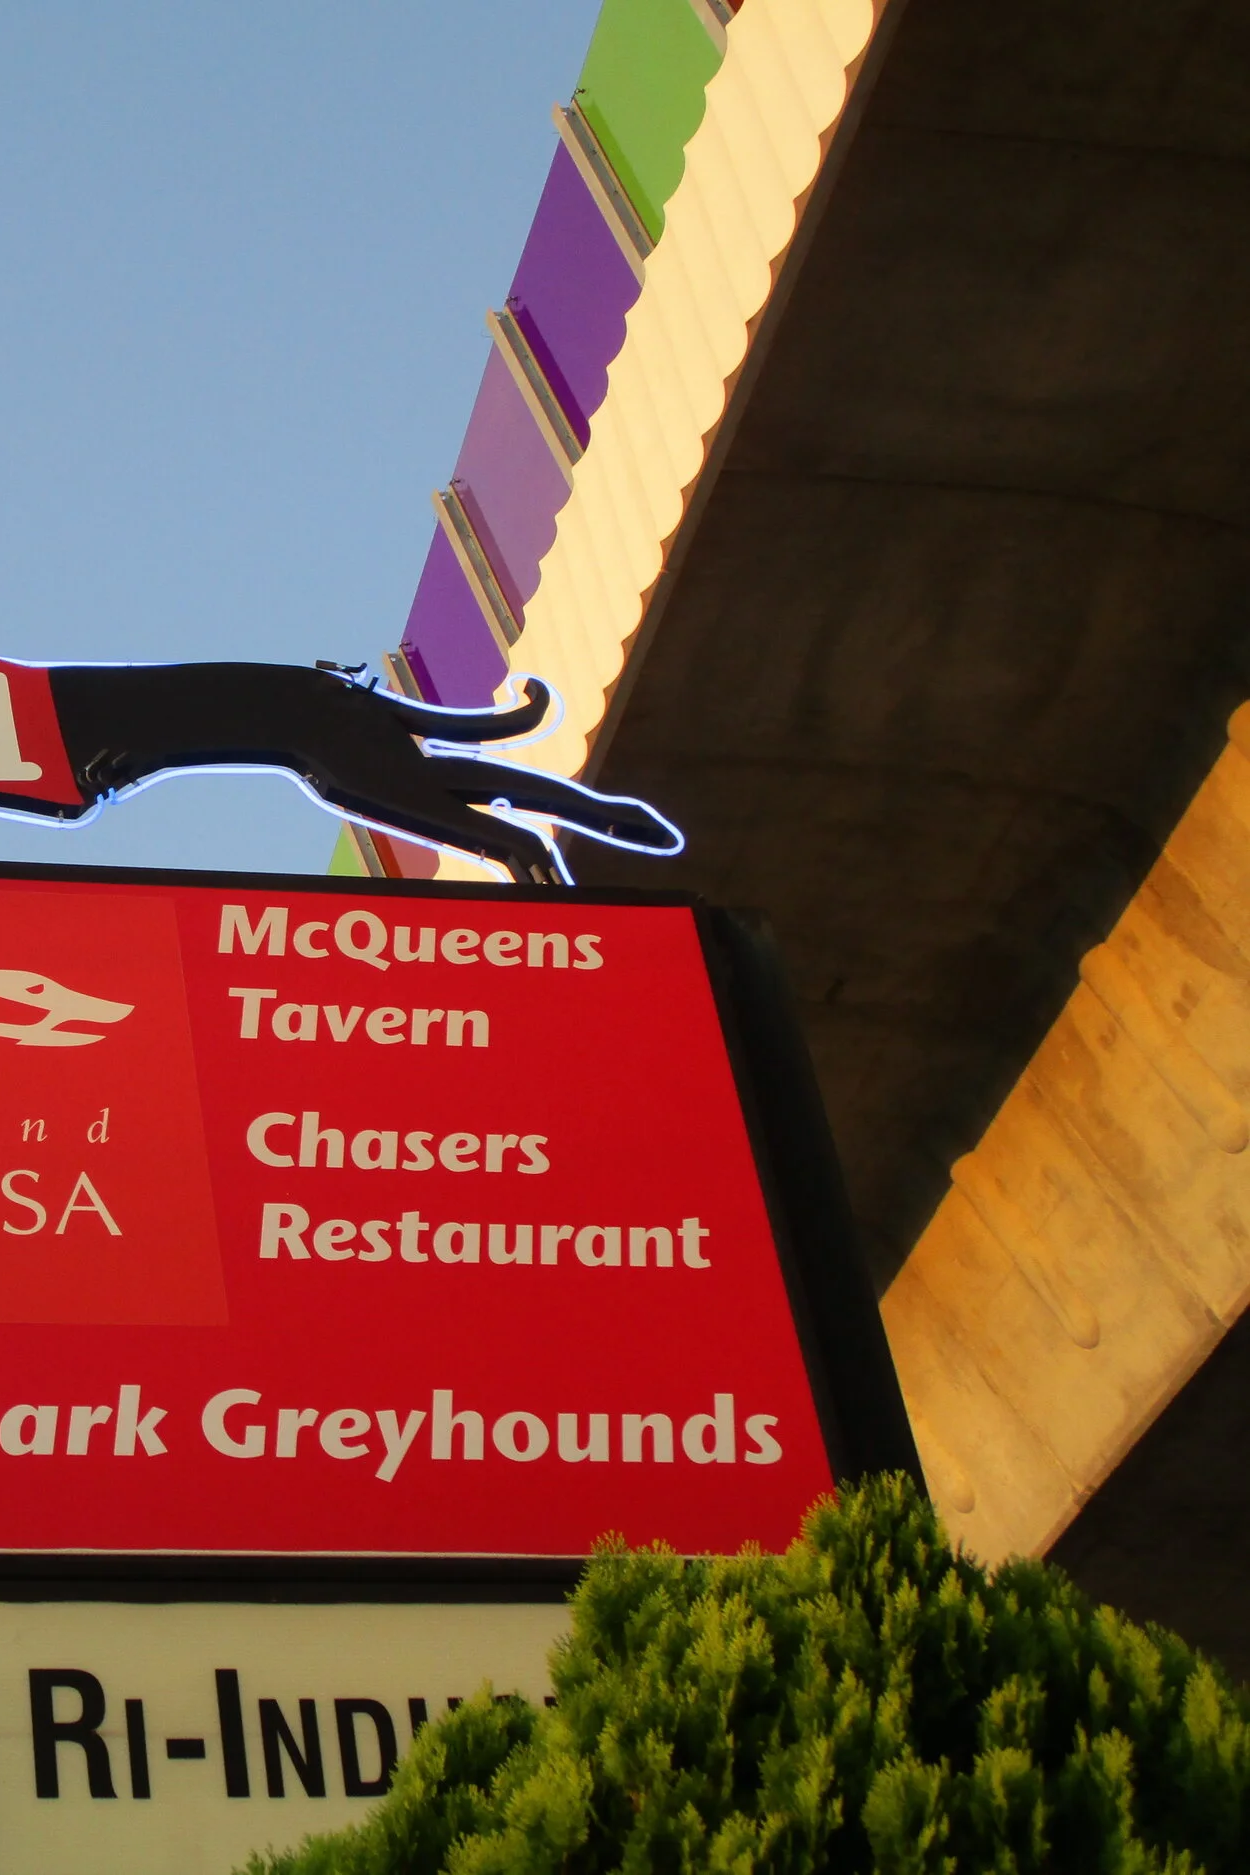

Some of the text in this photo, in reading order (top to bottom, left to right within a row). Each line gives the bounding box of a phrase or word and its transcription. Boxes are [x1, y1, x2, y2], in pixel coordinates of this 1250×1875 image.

[218, 905, 603, 971] McQueens
[229, 988, 489, 1047] Tavern
[247, 1112, 550, 1174] Chasers
[1, 1170, 122, 1235] SA
[260, 1203, 711, 1268] Restaurant
[202, 1389, 782, 1482] Greyhounds
